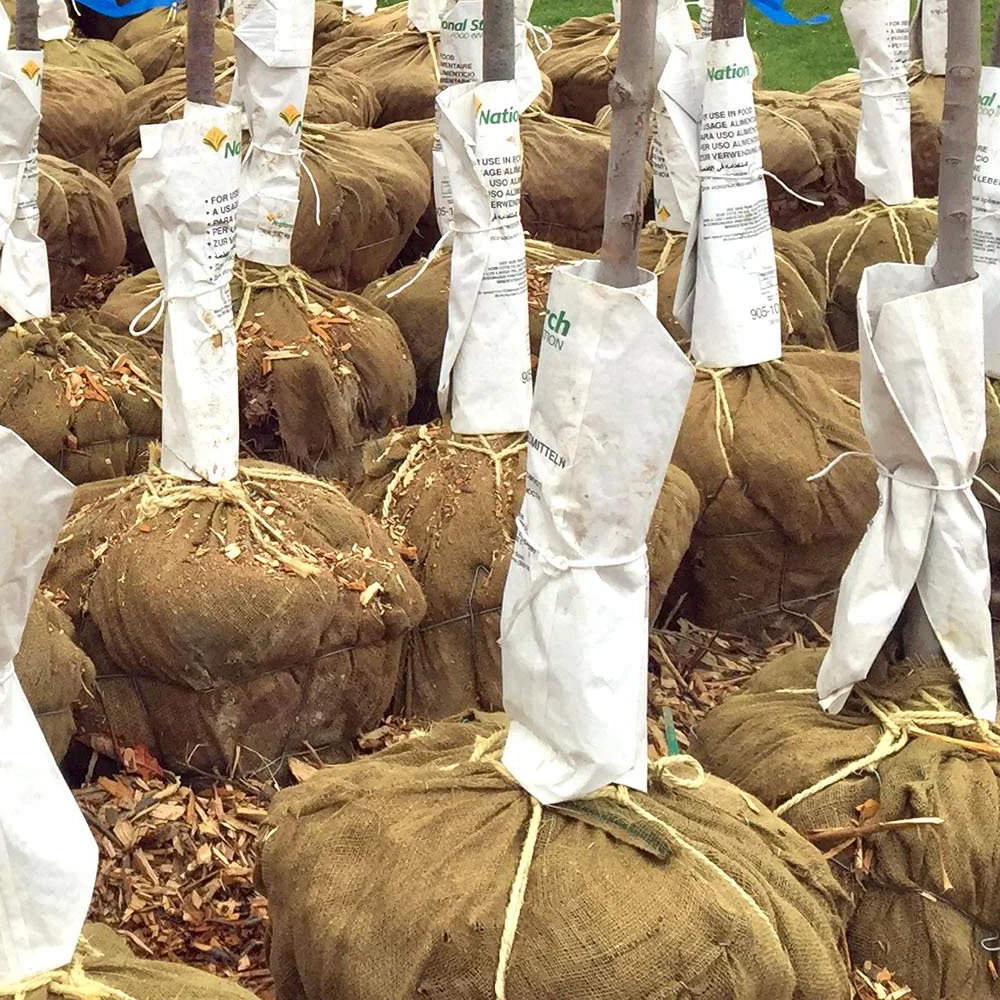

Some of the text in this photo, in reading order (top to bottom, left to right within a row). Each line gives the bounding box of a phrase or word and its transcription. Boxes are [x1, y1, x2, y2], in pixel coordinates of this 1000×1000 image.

[707, 63, 750, 82] Nation
[708, 111, 726, 120] USE
[716, 131, 735, 140] USO
[711, 141, 731, 150] USO
[482, 157, 501, 166] USE
[489, 178, 509, 188] USO
[211, 193, 228, 205] FOR
[212, 208, 219, 216] A
[213, 238, 228, 248] ZUR
